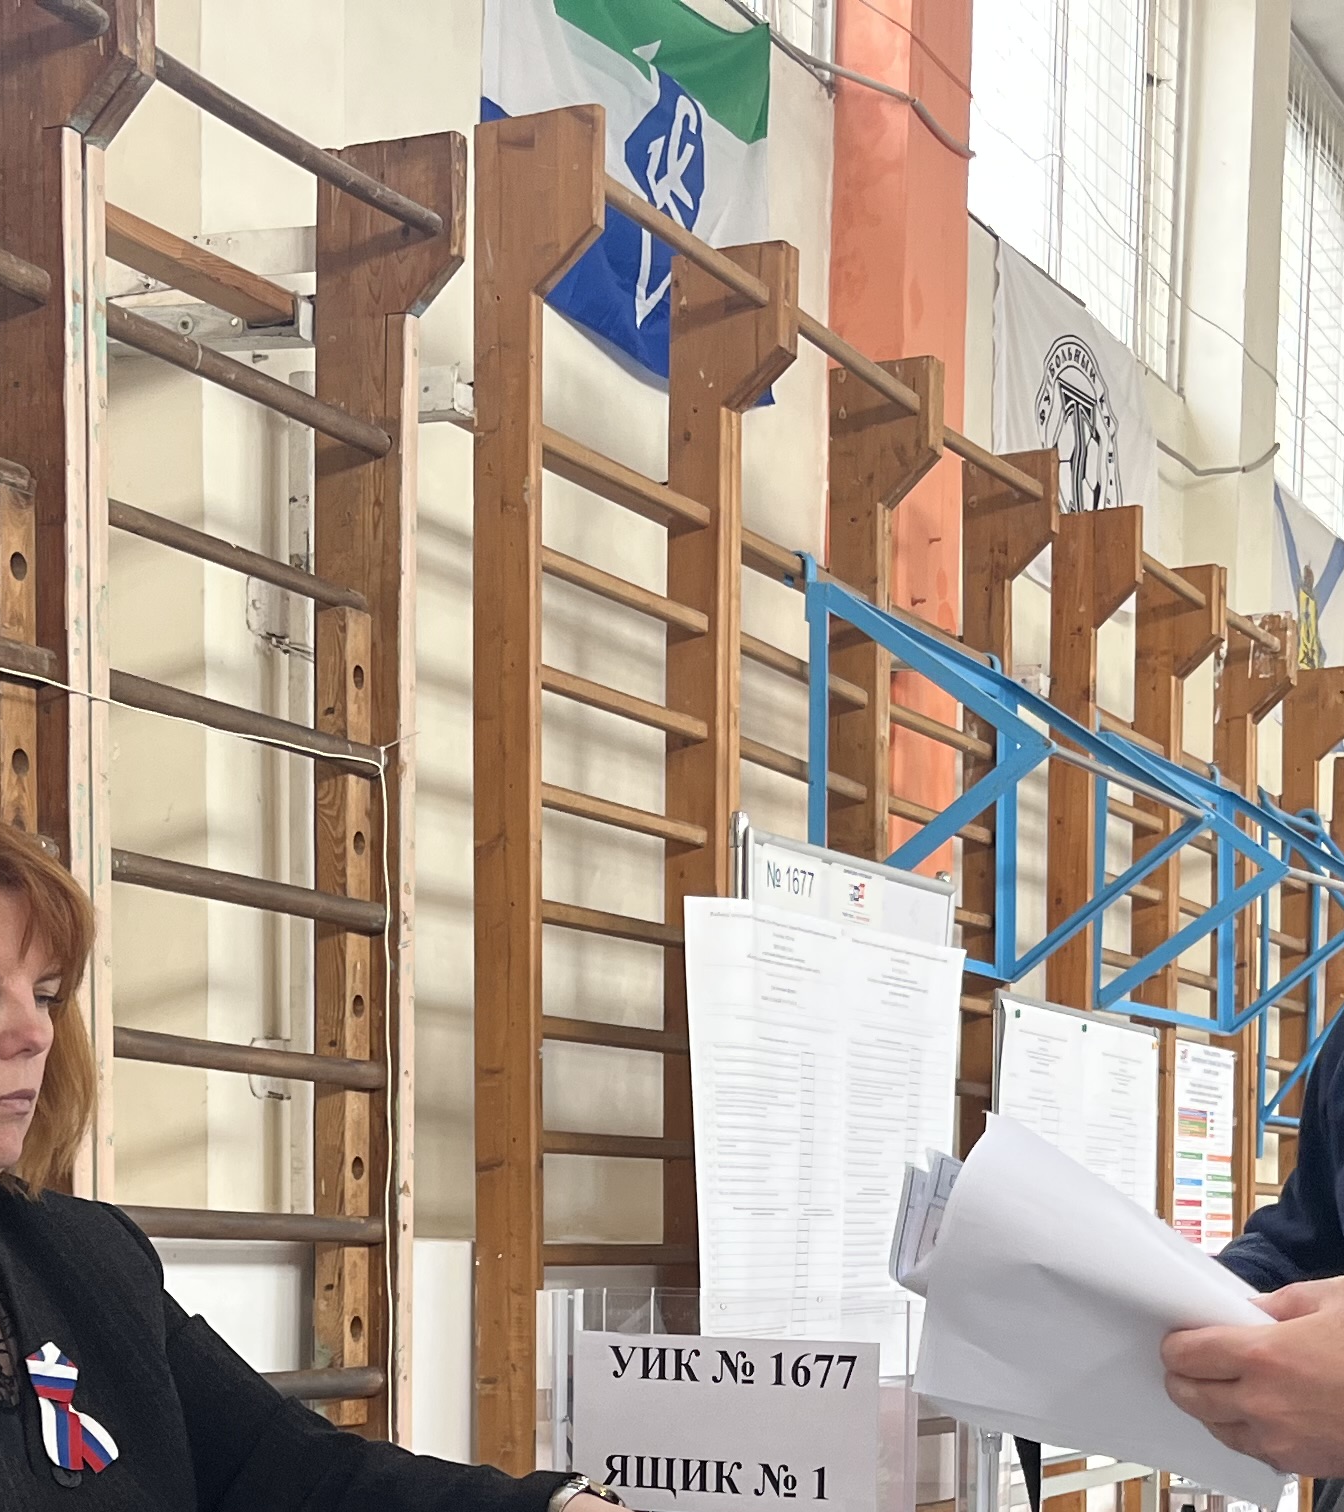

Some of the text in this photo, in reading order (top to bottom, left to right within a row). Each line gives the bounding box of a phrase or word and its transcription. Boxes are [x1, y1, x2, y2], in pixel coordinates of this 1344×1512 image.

[767, 860, 815, 898] № 1677
[608, 1345, 858, 1389] УИК № 1677
[603, 1454, 830, 1500] ЯЩИК № 1
